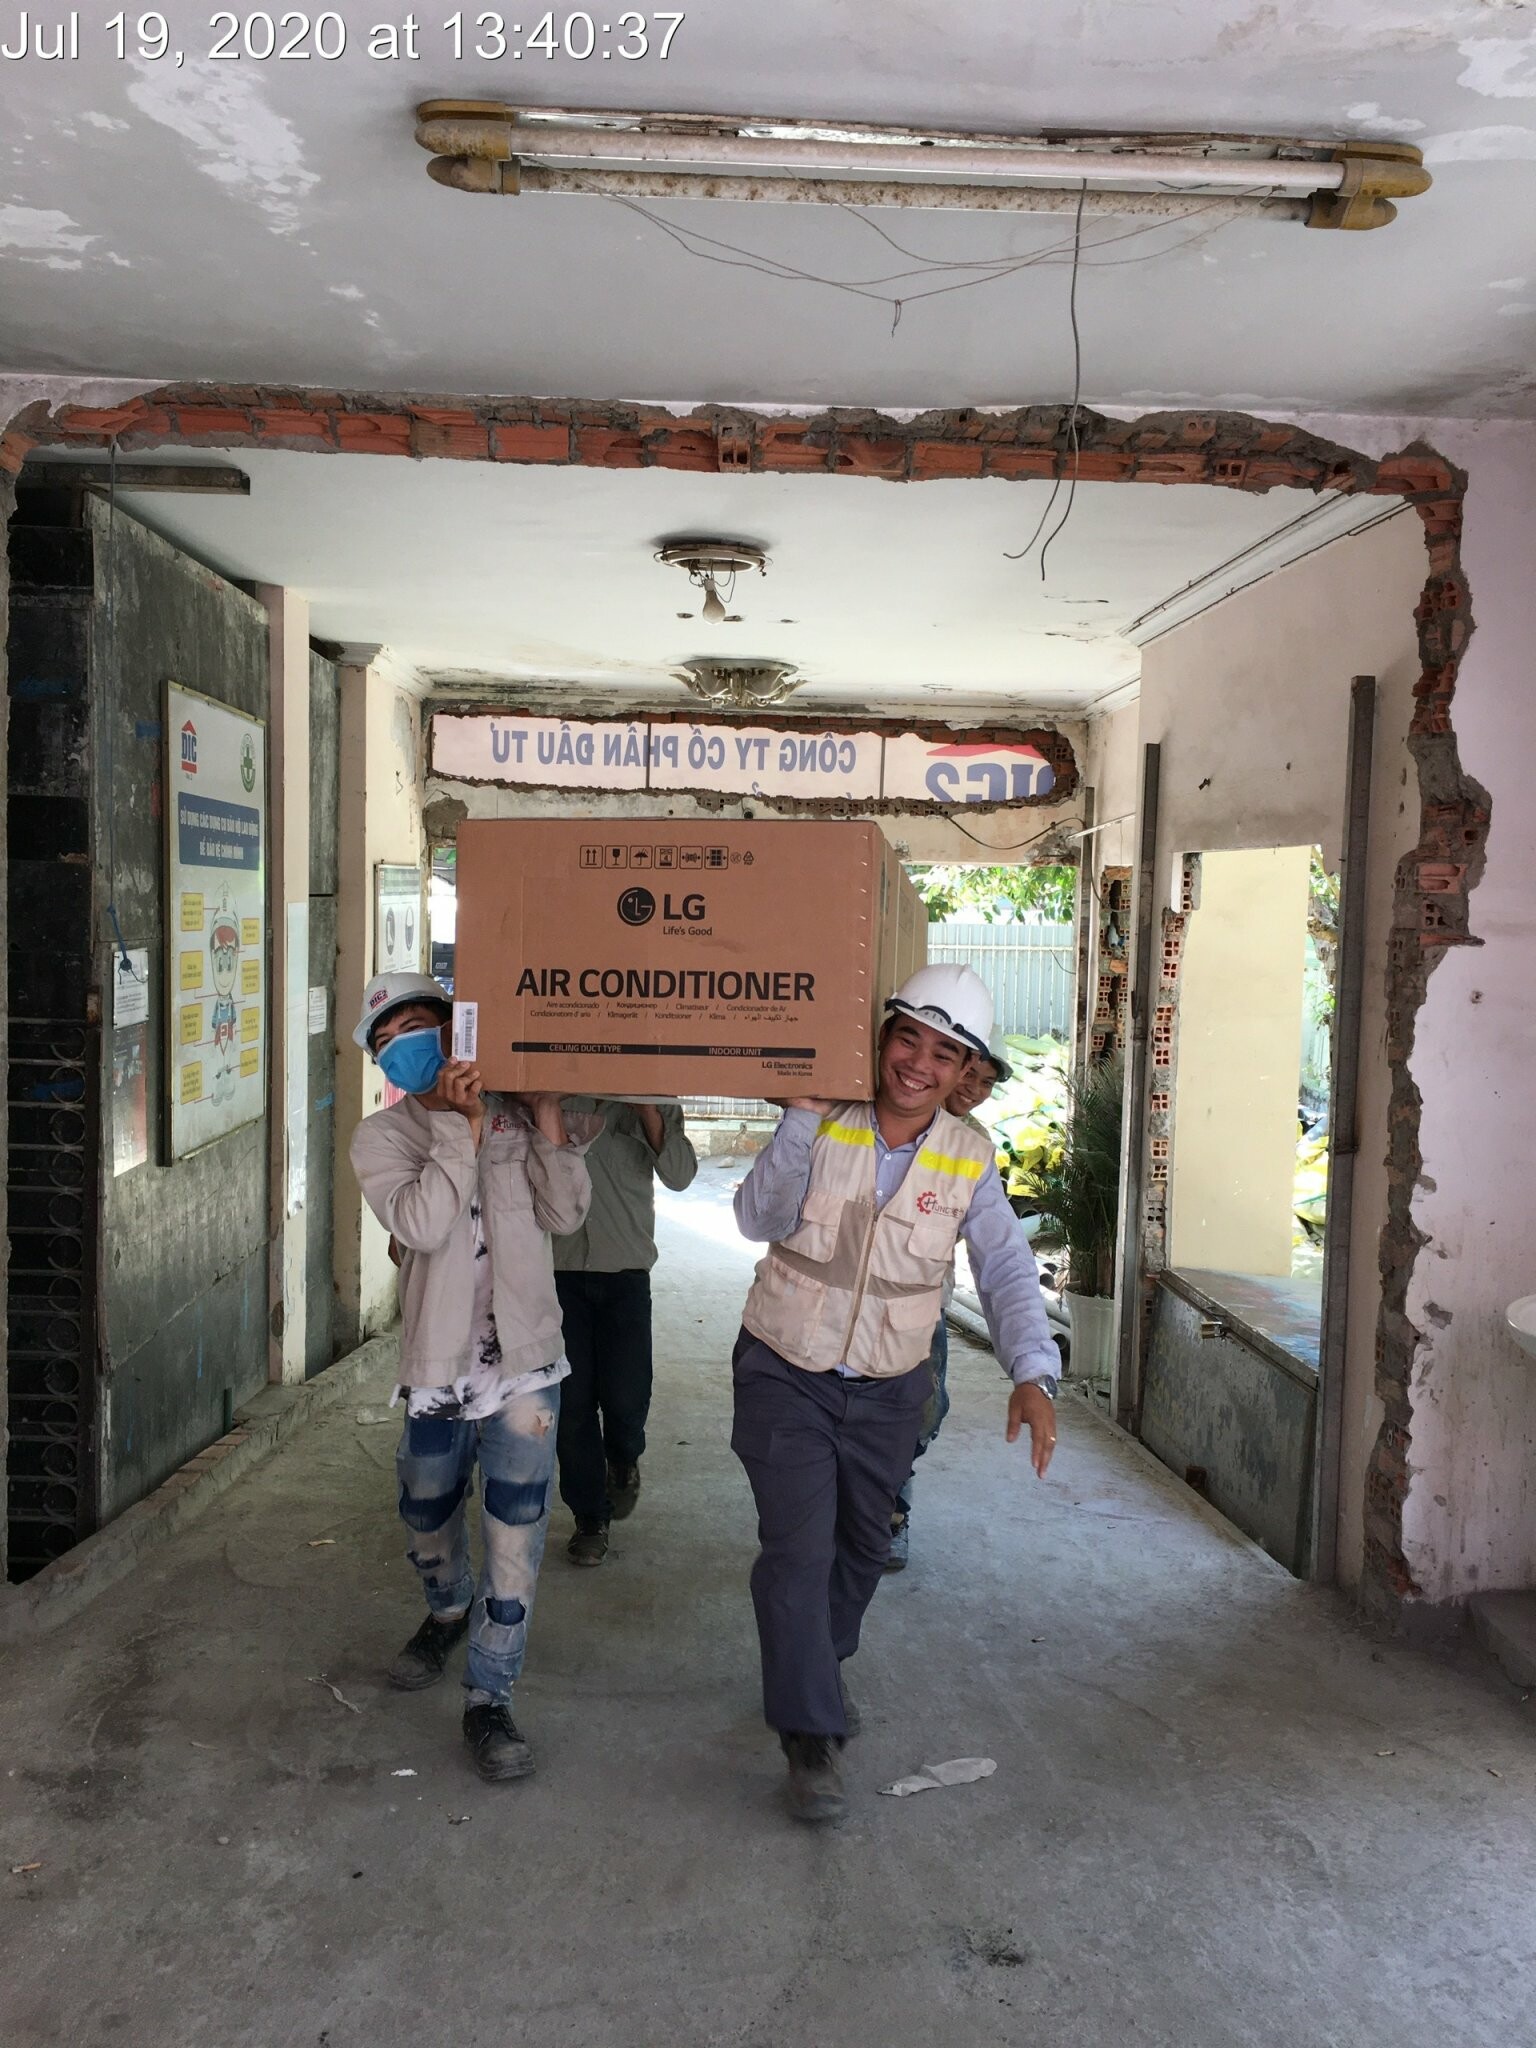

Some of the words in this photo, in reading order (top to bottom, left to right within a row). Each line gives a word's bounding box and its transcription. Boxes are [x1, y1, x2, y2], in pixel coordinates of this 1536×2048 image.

[181, 732, 197, 763] DIC
[663, 894, 706, 920] LG
[663, 926, 686, 936] Life's
[688, 926, 713, 936] Good
[515, 968, 571, 997] AIR
[579, 969, 815, 1002] CONDITIONER
[549, 1043, 580, 1052] CEILING
[580, 1044, 602, 1053] DUCT
[603, 1044, 622, 1053] TYPE
[709, 1047, 741, 1056] INDOOR
[742, 1048, 762, 1056] UNIT
[761, 1061, 773, 1069] LG
[774, 1061, 813, 1070] Electronics
